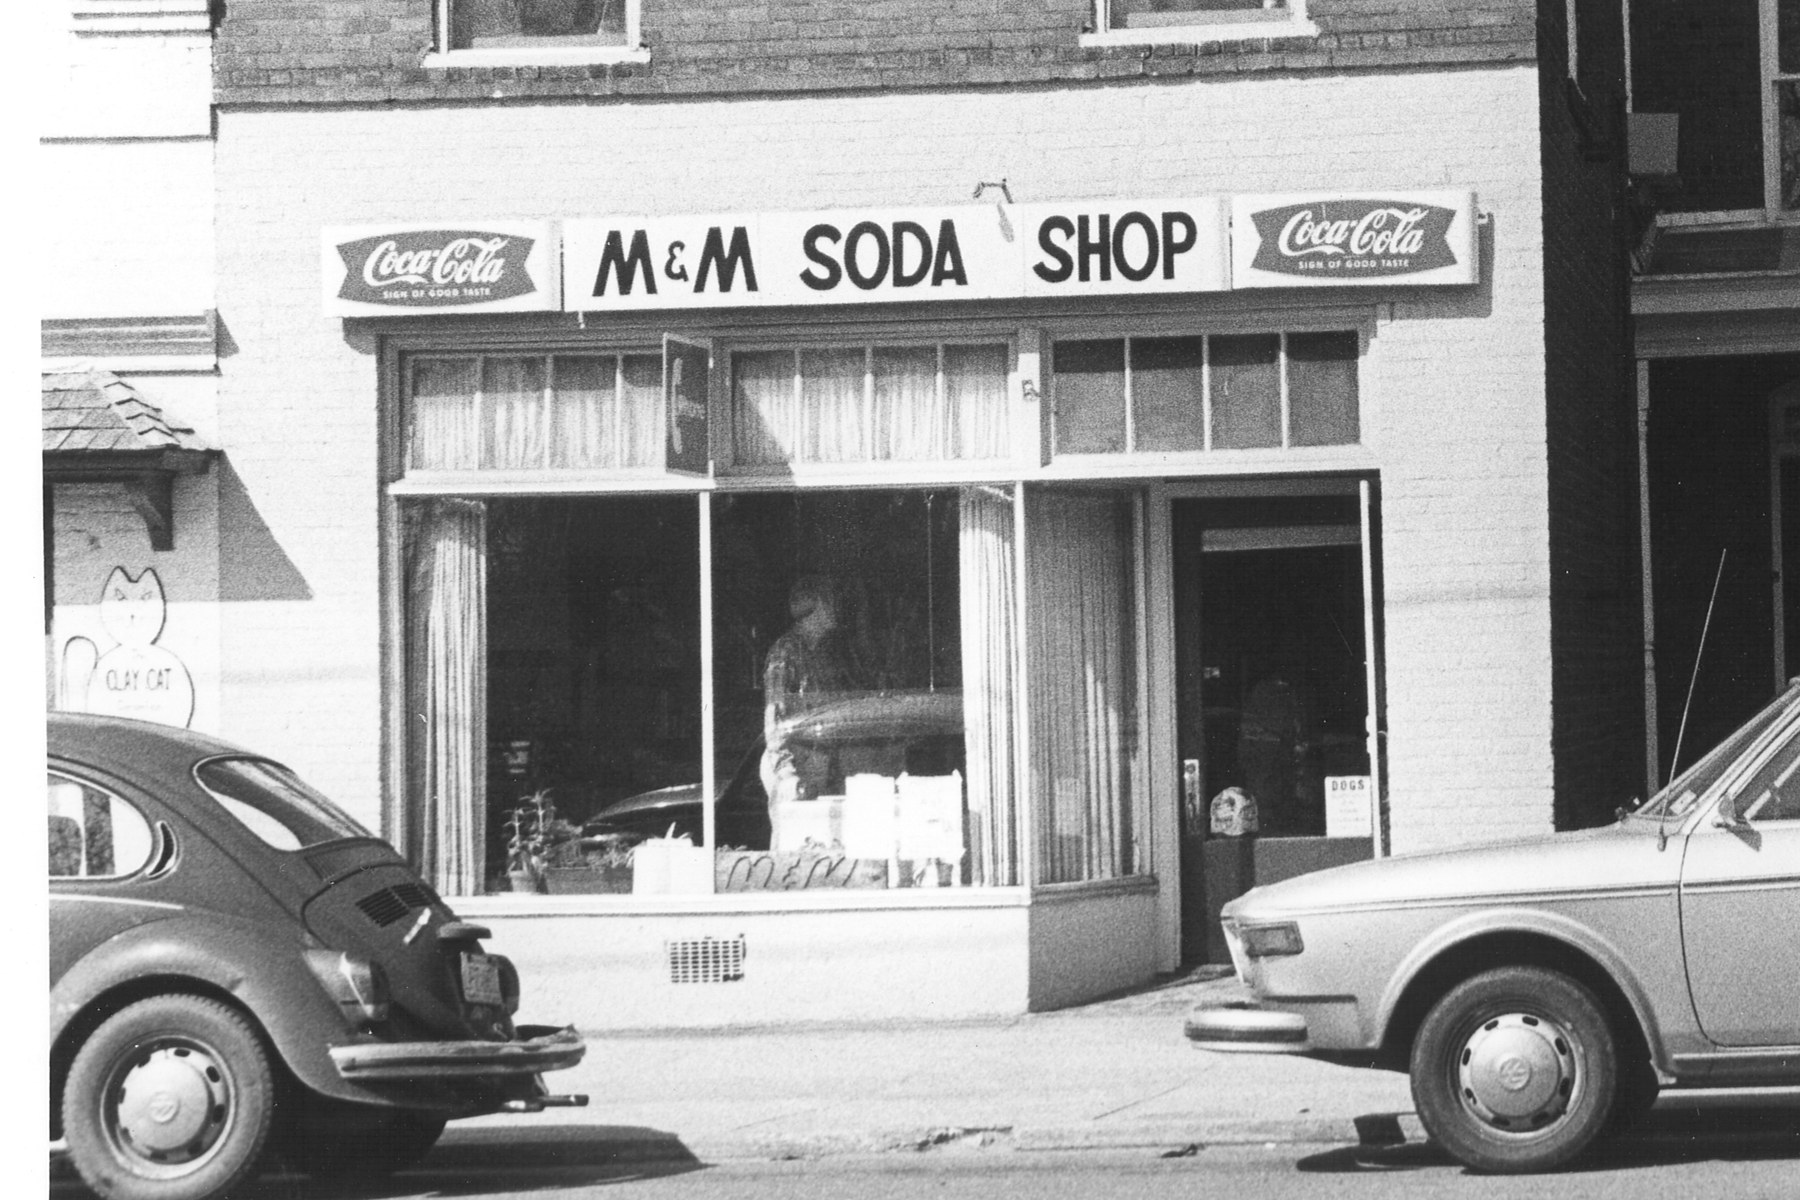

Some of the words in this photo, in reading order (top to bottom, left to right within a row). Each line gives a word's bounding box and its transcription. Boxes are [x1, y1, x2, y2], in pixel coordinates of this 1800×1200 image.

[1278, 207, 1430, 257] Coca-Cola
[362, 237, 510, 287] Coca-Cola
[799, 220, 968, 291] SODA
[1032, 211, 1198, 284] SHOP
[1298, 261, 1324, 270] SIGN
[1328, 260, 1342, 269] OF
[1345, 259, 1377, 269] GOOD
[1381, 259, 1410, 268] TASTE
[383, 290, 408, 299] SIGN
[411, 290, 426, 299] OF
[429, 288, 460, 298] GOOD
[463, 287, 491, 297] TASTE
[106, 669, 140, 691] CLAY
[146, 667, 172, 691] CAT
[1331, 778, 1366, 792] DOGS
